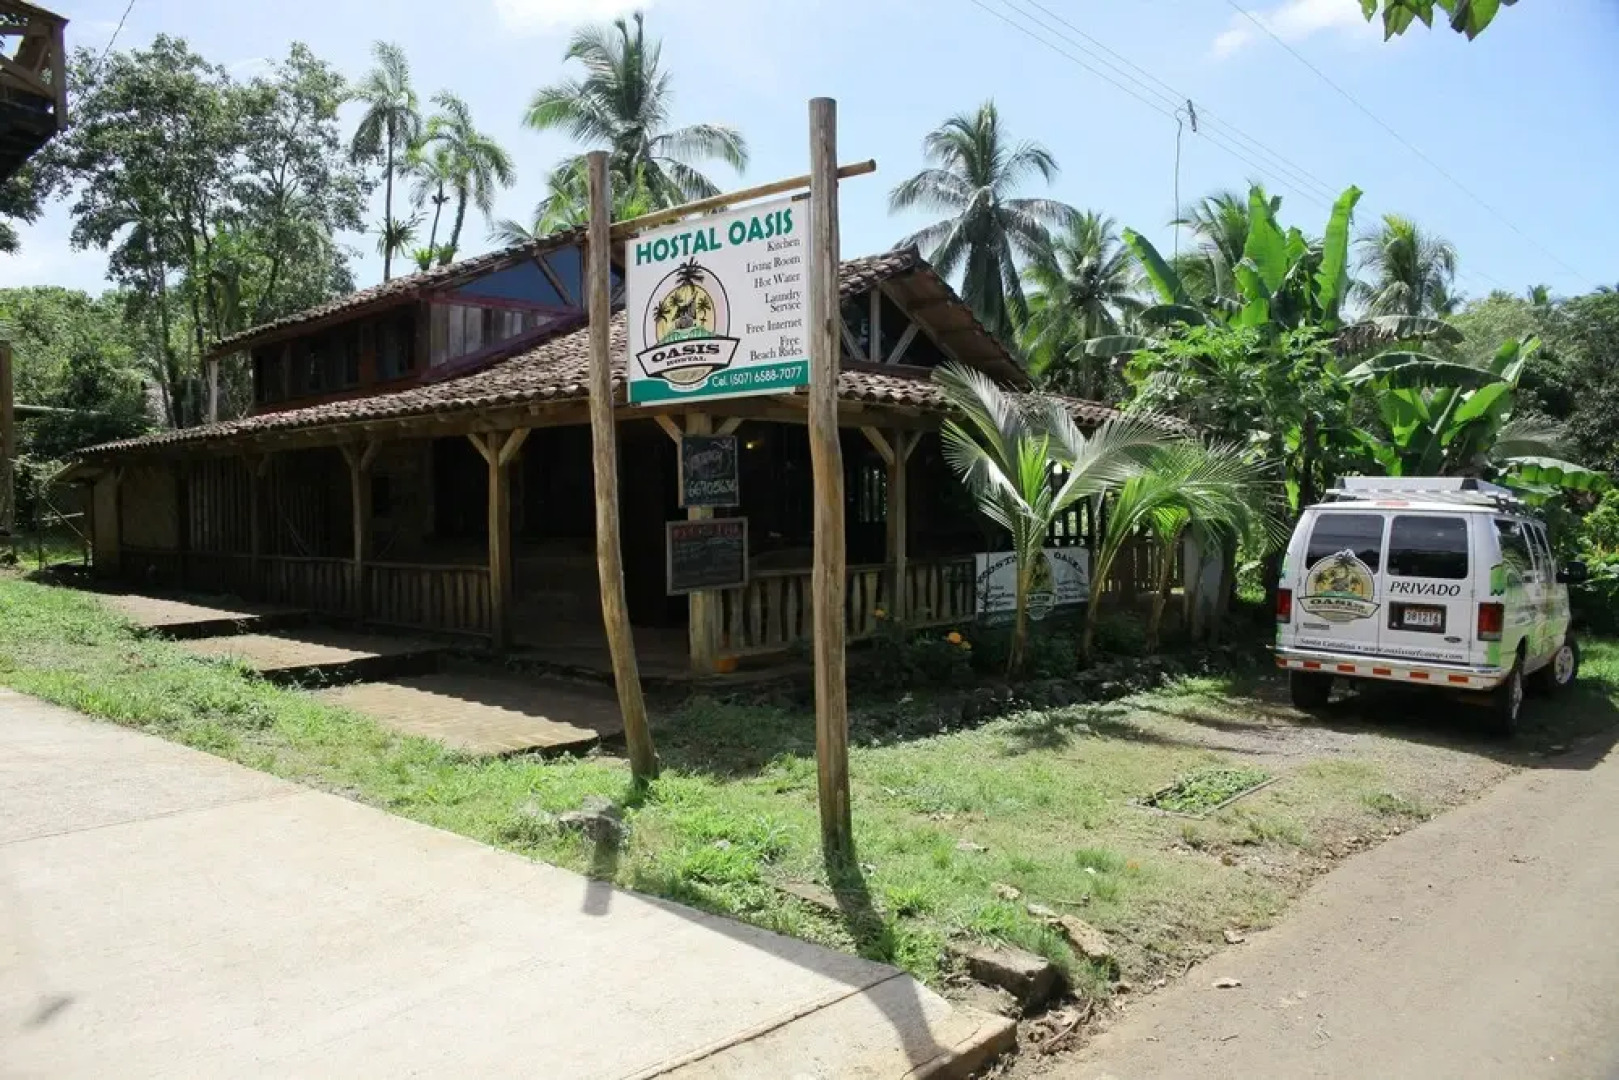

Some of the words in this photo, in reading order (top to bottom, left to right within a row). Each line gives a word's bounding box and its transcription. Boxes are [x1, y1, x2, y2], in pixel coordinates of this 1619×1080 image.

[635, 227, 722, 266] HOSTAL
[728, 208, 793, 246] OASIS
[767, 238, 800, 251] Kitchen
[746, 262, 771, 273] Living
[773, 256, 800, 268] Room
[754, 278, 771, 288] Hot
[773, 273, 800, 284] Water
[765, 289, 801, 303] Laundry
[770, 302, 801, 313] Service
[746, 323, 765, 334] Free
[767, 319, 802, 331] Internet
[779, 336, 800, 346] Free
[651, 345, 719, 362] OASIS
[750, 348, 776, 361] Beach
[778, 345, 803, 357] Rides
[711, 376, 728, 388] Cel.
[729, 371, 752, 386] (507)
[754, 366, 803, 383] 6588-7077
[1390, 581, 1461, 596] PRIVADO
[1310, 598, 1365, 609] OASIS
